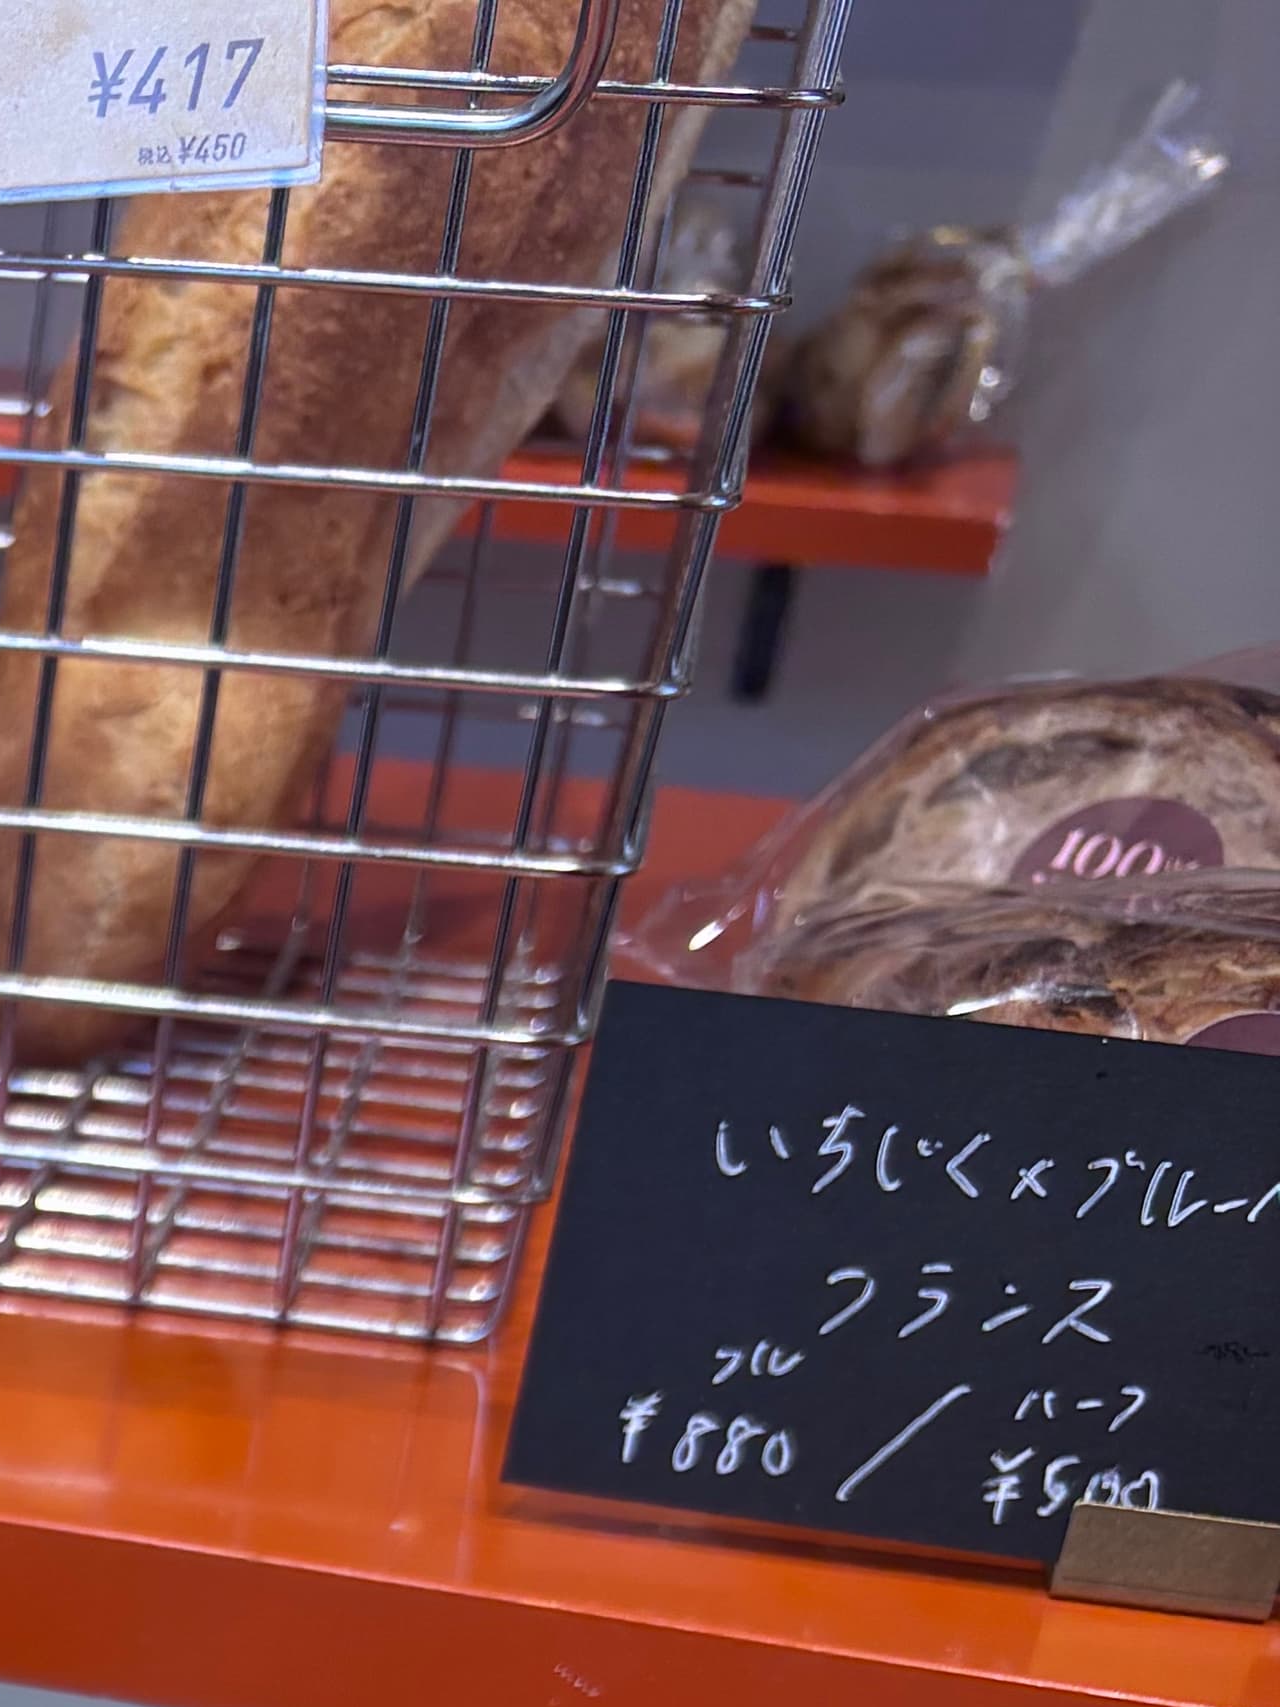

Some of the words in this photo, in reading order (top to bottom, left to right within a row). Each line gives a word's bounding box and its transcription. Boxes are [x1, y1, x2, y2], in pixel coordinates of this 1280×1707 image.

[88, 37, 265, 118] ¥417
[178, 132, 248, 165] ¥450
[818, 1263, 1113, 1343] フランス
[712, 1339, 806, 1385] フル
[1014, 1385, 1146, 1433] ハーフ
[619, 1391, 793, 1477] ¥880
